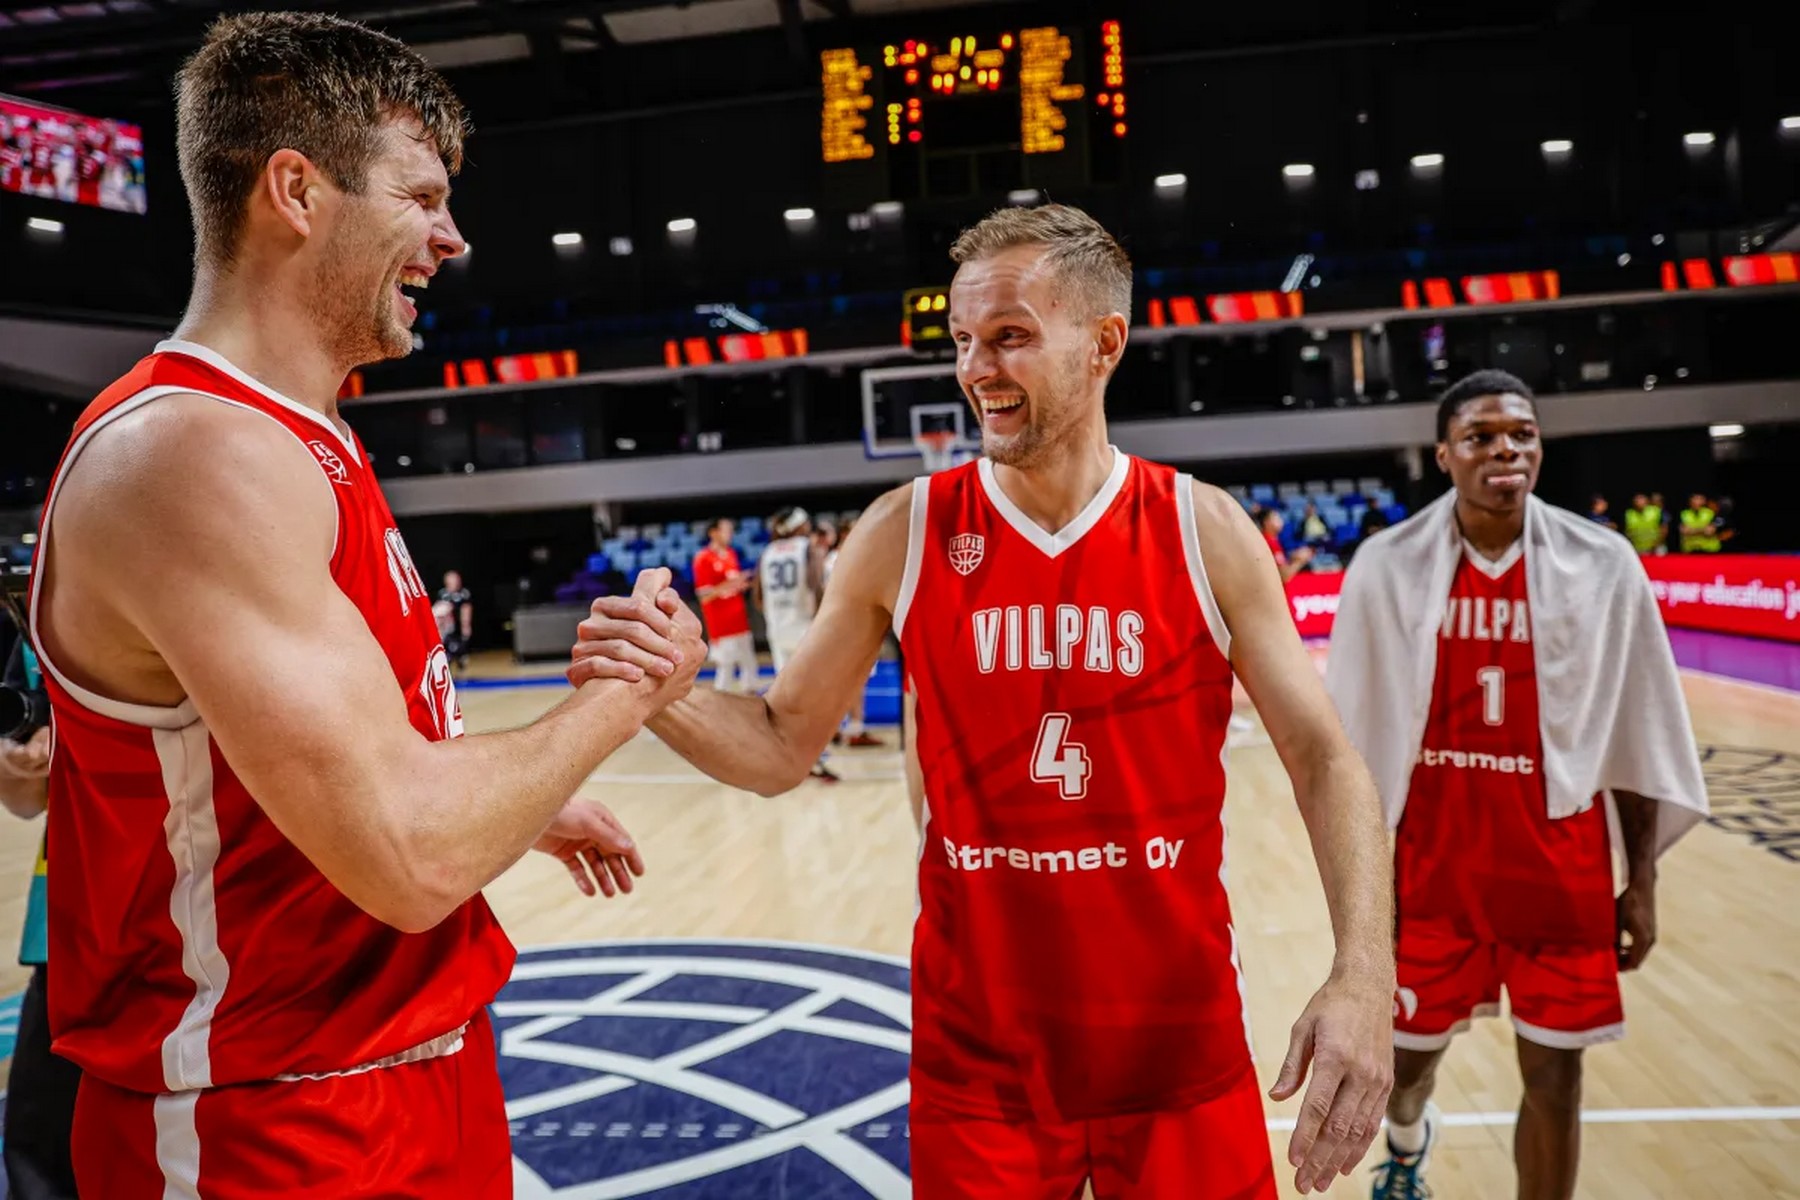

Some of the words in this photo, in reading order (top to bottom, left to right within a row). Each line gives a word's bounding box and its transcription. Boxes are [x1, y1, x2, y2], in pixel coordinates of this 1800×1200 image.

[951, 536, 983, 552] VILPAS
[768, 559, 798, 591] 30
[1668, 581, 1701, 608] your
[1702, 574, 1786, 611] education
[972, 604, 1144, 678] VILPAS
[1440, 596, 1531, 644] VILPA
[1477, 666, 1505, 726] 1
[1030, 712, 1092, 801] 4
[943, 836, 1128, 873] Stremet
[1145, 835, 1185, 869] Oy
